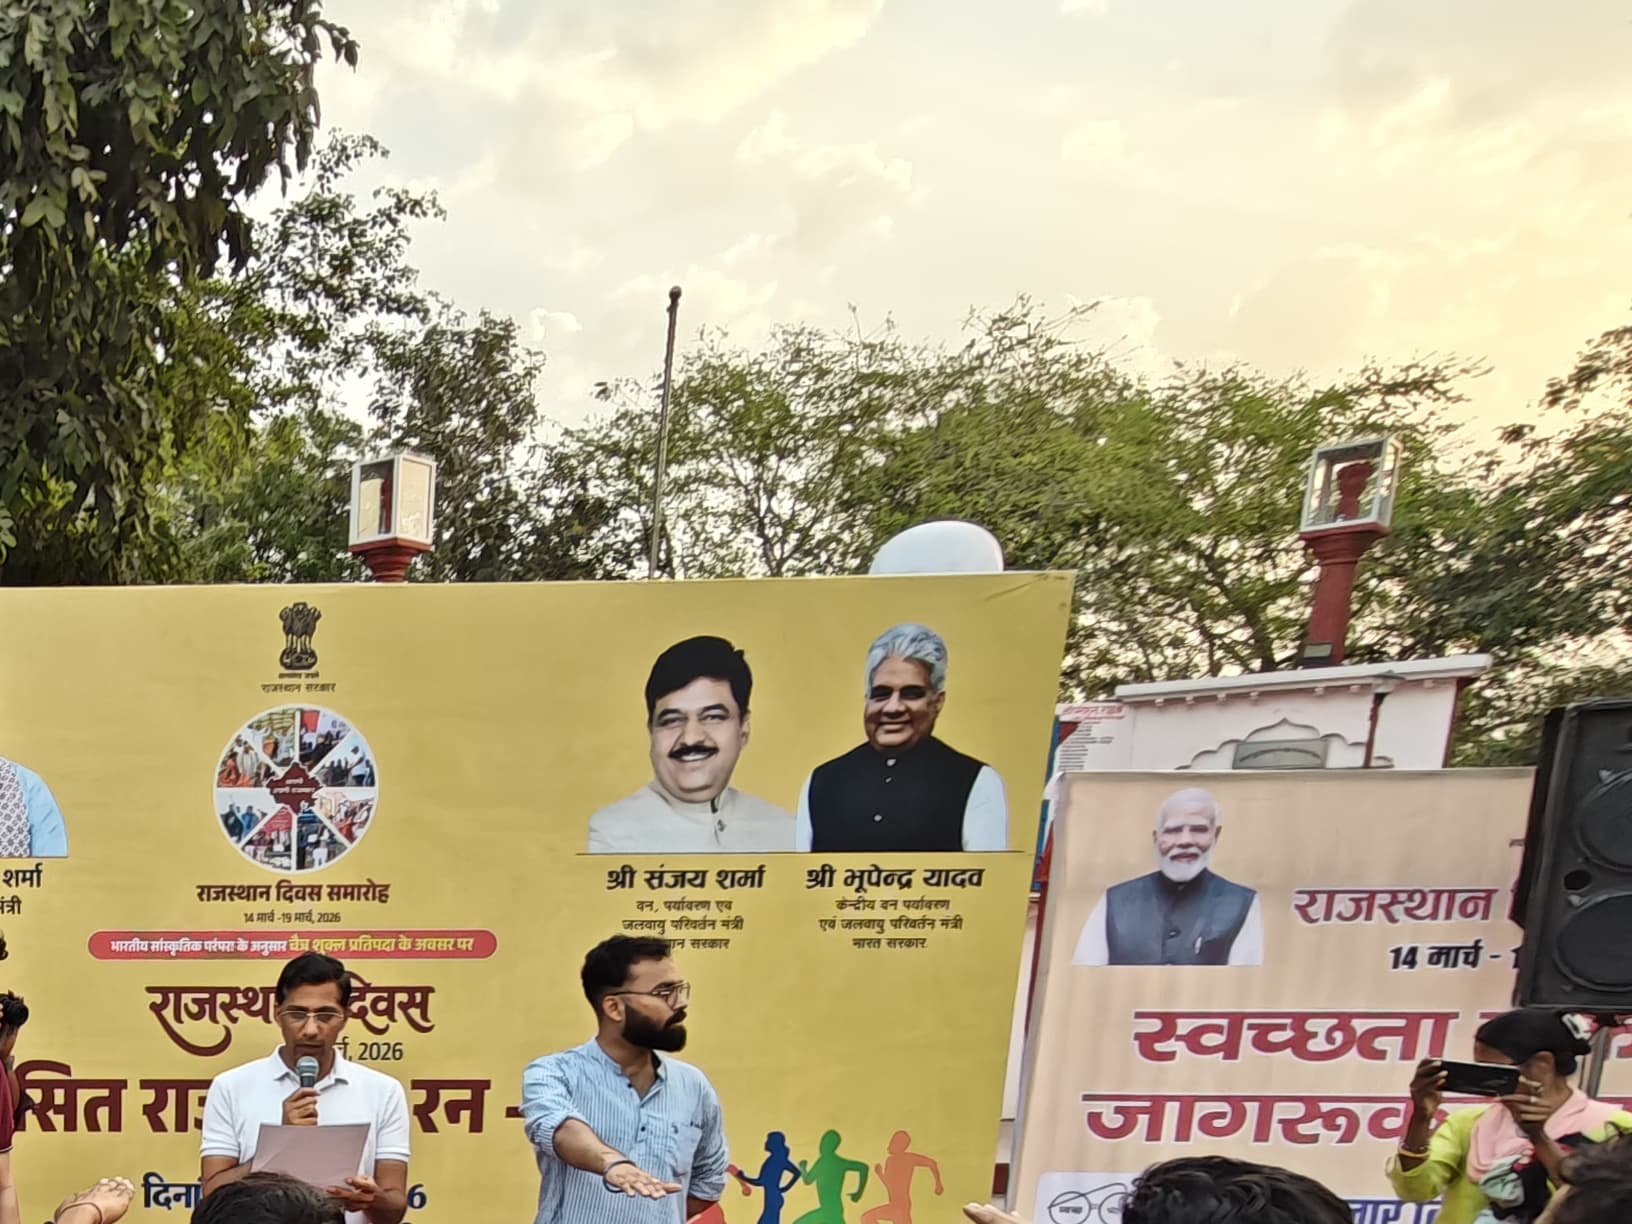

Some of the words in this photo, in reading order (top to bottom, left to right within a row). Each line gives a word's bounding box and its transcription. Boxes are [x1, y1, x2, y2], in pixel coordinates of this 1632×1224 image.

[2, 863, 42, 888] शर्मा
[607, 864, 636, 890] श्री
[644, 864, 708, 890] संजय
[715, 864, 766, 890] शर्मा
[806, 864, 836, 889] श्री
[843, 864, 915, 893] भूपेन्द्र
[923, 868, 985, 889] यादव
[197, 885, 271, 902] राजस्थान
[275, 879, 323, 903] दिवस
[326, 878, 390, 903] समारोह
[664, 896, 711, 912] पर्यावरण
[903, 895, 950, 911] पर्यावरण
[1294, 888, 1500, 924] राजस्थान
[244, 913, 255, 923] 14
[317, 913, 341, 923] 2026
[622, 919, 665, 935] जलवायु
[671, 915, 717, 930] परिवर्तन
[841, 918, 885, 933] जलवायु
[890, 915, 935, 930] परिवर्तन
[111, 937, 148, 952] भारतीय
[237, 938, 248, 952] के
[399, 935, 411, 951] के
[456, 938, 474, 951] पर
[690, 938, 730, 949] सरकार
[886, 938, 927, 949] सरकार
[1389, 946, 1418, 969] 14
[1427, 939, 1483, 968] मार्च
[1134, 1011, 1460, 1062] स्वच्छता
[358, 1042, 404, 1061] 2026
[411, 1080, 491, 1133] रन
